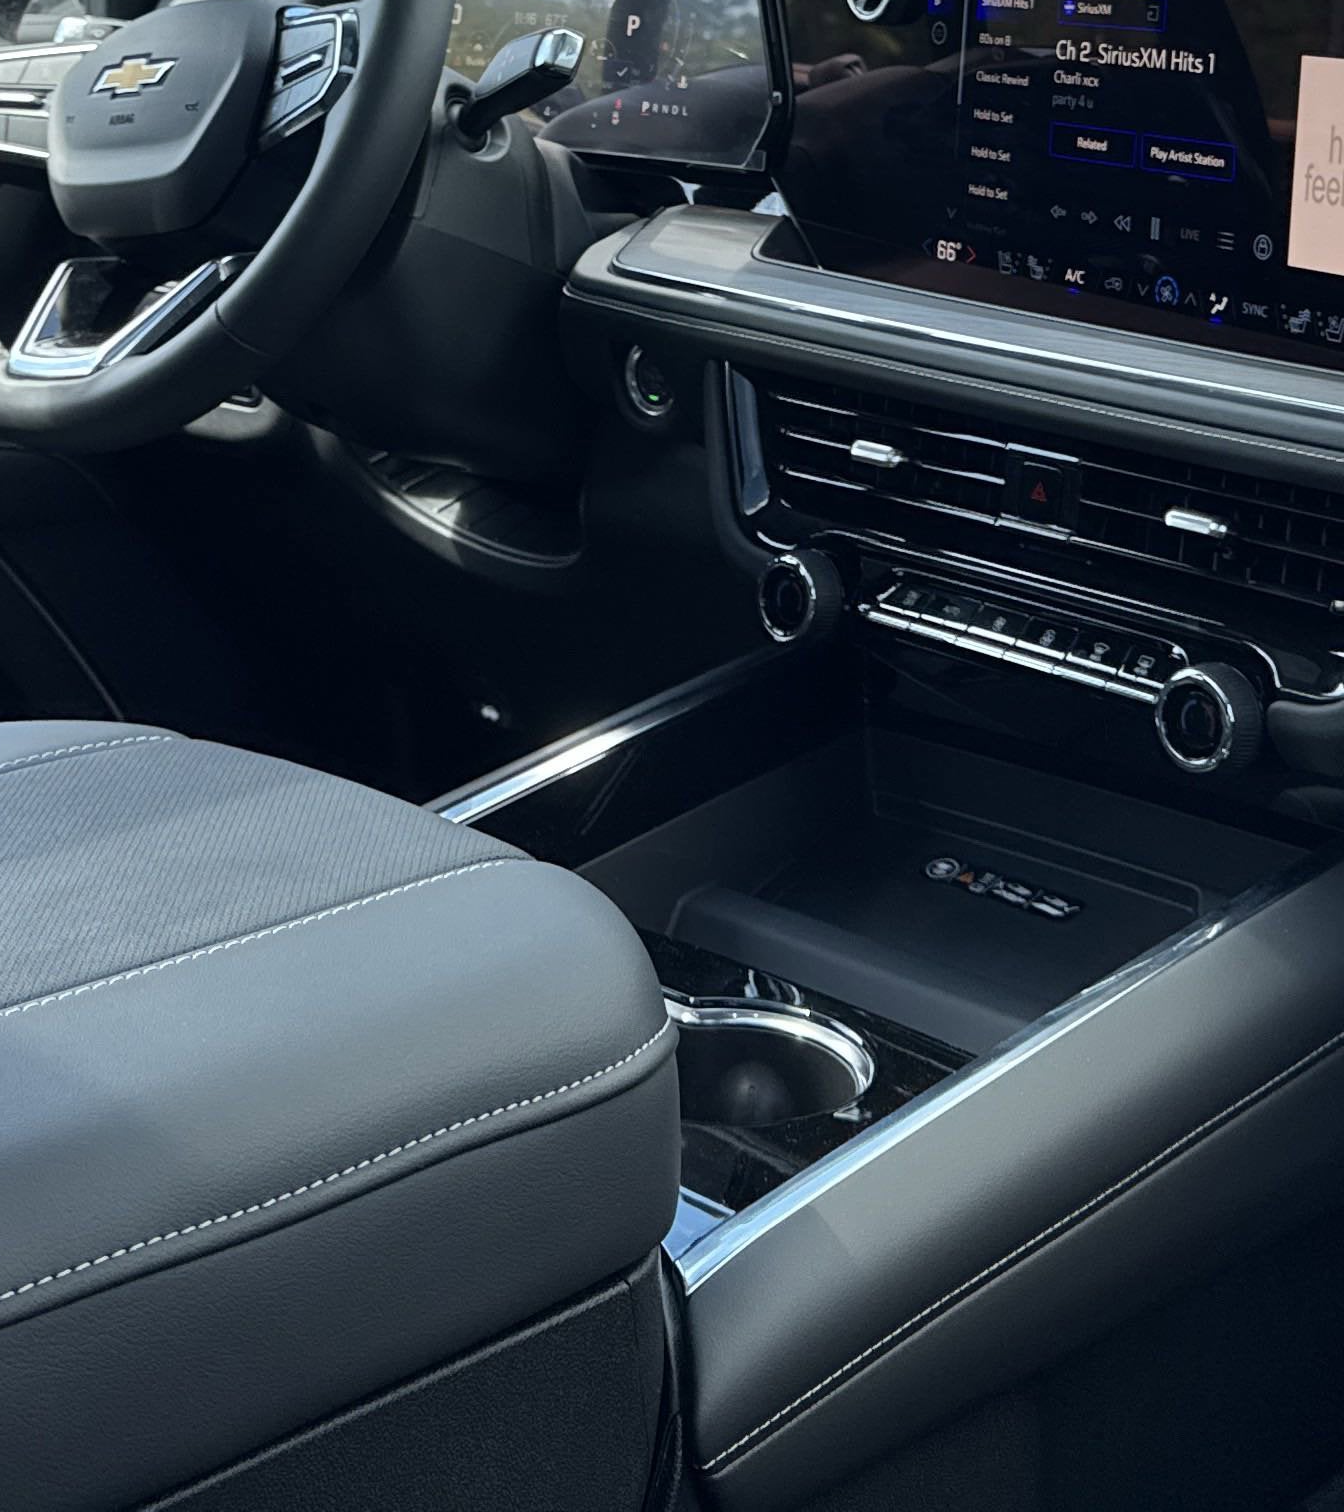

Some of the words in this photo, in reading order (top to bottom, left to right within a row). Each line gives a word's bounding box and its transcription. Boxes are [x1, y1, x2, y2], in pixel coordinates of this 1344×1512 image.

[626, 14, 641, 37] P
[1056, 40, 1076, 61] Ch
[1080, 41, 1090, 62] 2
[1097, 44, 1166, 70] SiriusXM
[1170, 50, 1204, 74] Hits
[1208, 53, 1215, 74] 1
[975, 70, 1000, 84] Classic
[1001, 74, 1029, 87] Rewind
[1054, 70, 1081, 87] Charli
[1082, 77, 1099, 88] xcx
[641, 101, 650, 114] P
[661, 104, 669, 114] N
[671, 105, 679, 115] D
[682, 106, 688, 116] L
[1051, 93, 1077, 110] party
[1078, 95, 1086, 108] 4
[1086, 99, 1094, 109] u
[973, 109, 990, 122] Hold
[991, 112, 999, 123] to
[1000, 111, 1014, 124] Set
[1076, 136, 1108, 152] Related
[971, 146, 987, 159] Hold
[988, 149, 996, 160] to
[997, 149, 1011, 162] Set
[1150, 147, 1169, 163] Play
[1168, 150, 1193, 165] Artist
[1194, 153, 1225, 168] Station
[968, 183, 986, 196] Hold
[986, 187, 994, 198] to
[994, 187, 1008, 201] Set
[1180, 227, 1200, 241] LIVE
[936, 240, 962, 262] 66°
[1064, 267, 1086, 287] A/C
[1241, 301, 1270, 319] SYNC
